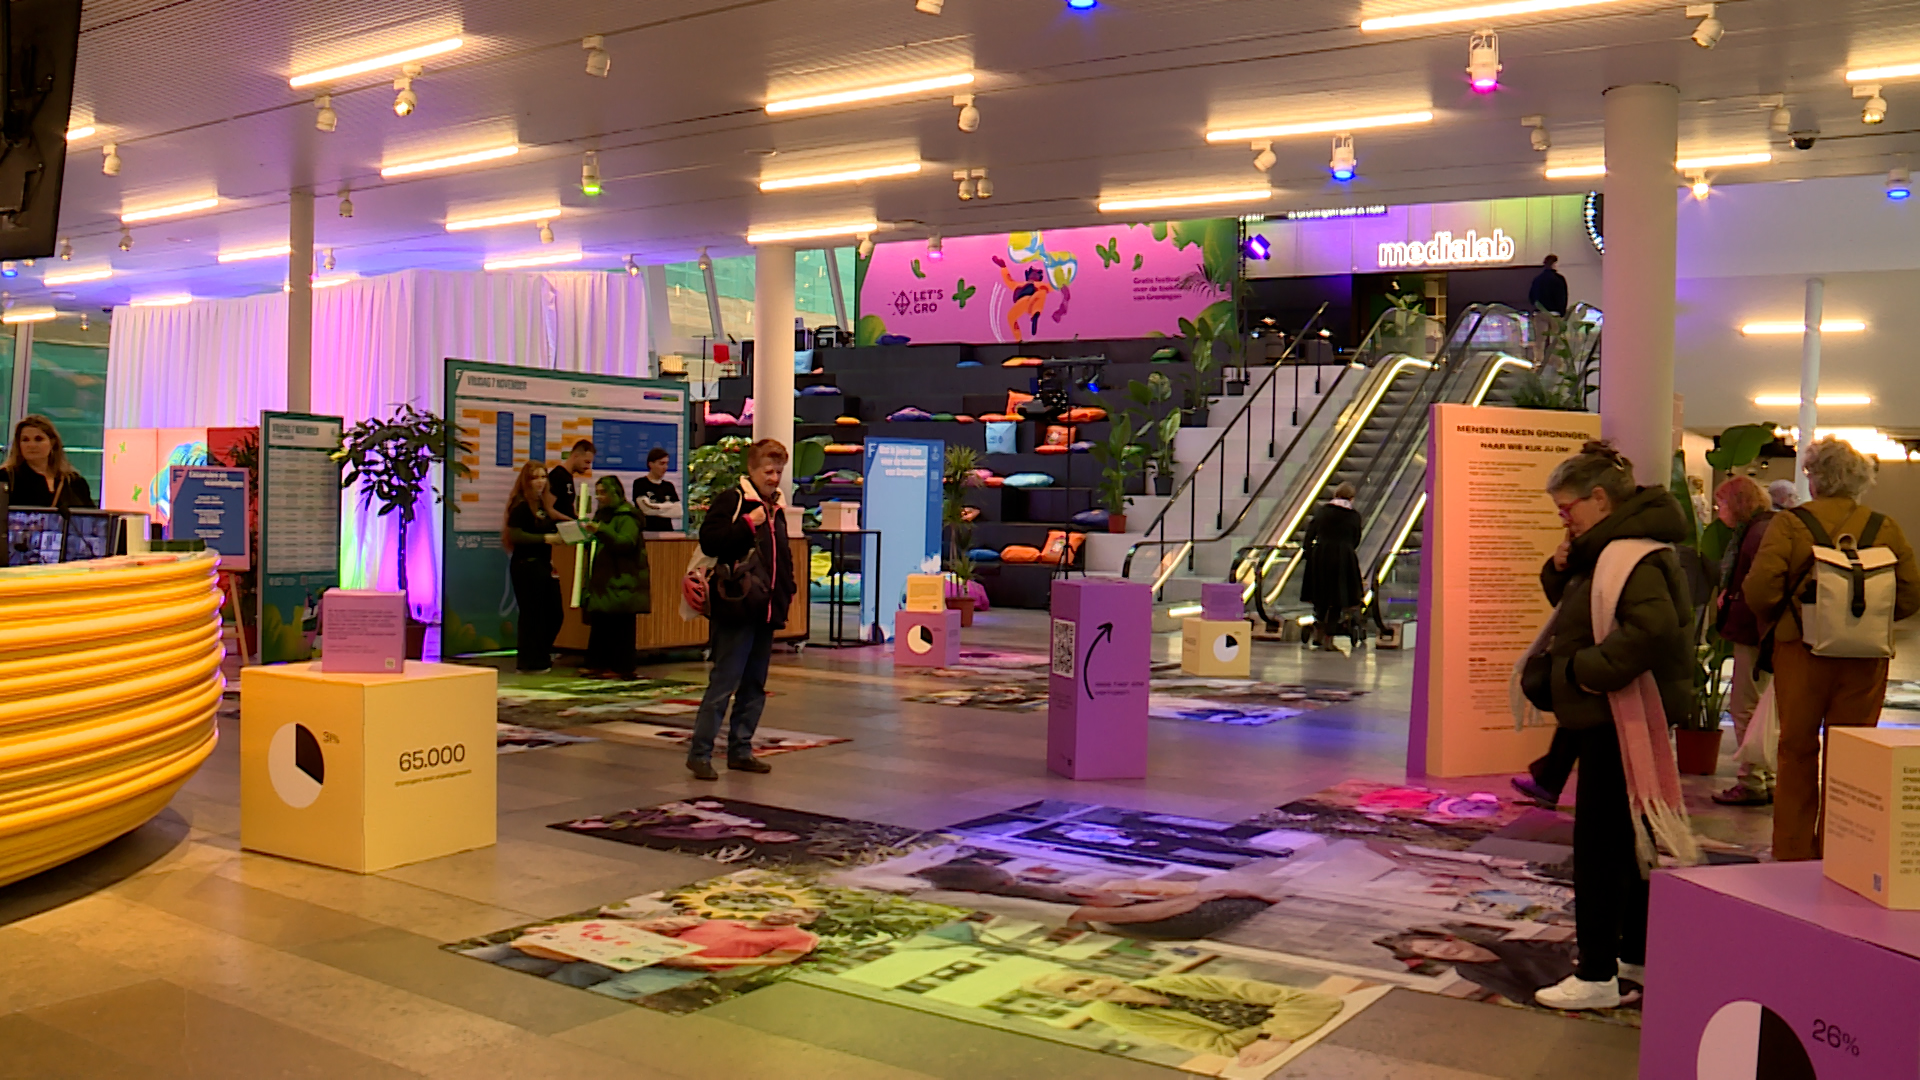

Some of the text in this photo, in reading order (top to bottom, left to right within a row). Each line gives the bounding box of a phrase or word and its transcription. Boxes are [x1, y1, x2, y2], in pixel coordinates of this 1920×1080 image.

[1379, 229, 1515, 267] medialab
[913, 289, 944, 302] LET'S
[914, 302, 938, 314] GRO
[1456, 425, 1499, 434] MENSEN
[1500, 427, 1535, 437] MAKEN
[1480, 442, 1506, 450] NAAR
[1507, 443, 1523, 451] WIE
[399, 743, 466, 772] 65.000
[1812, 1018, 1860, 1057] 26%
